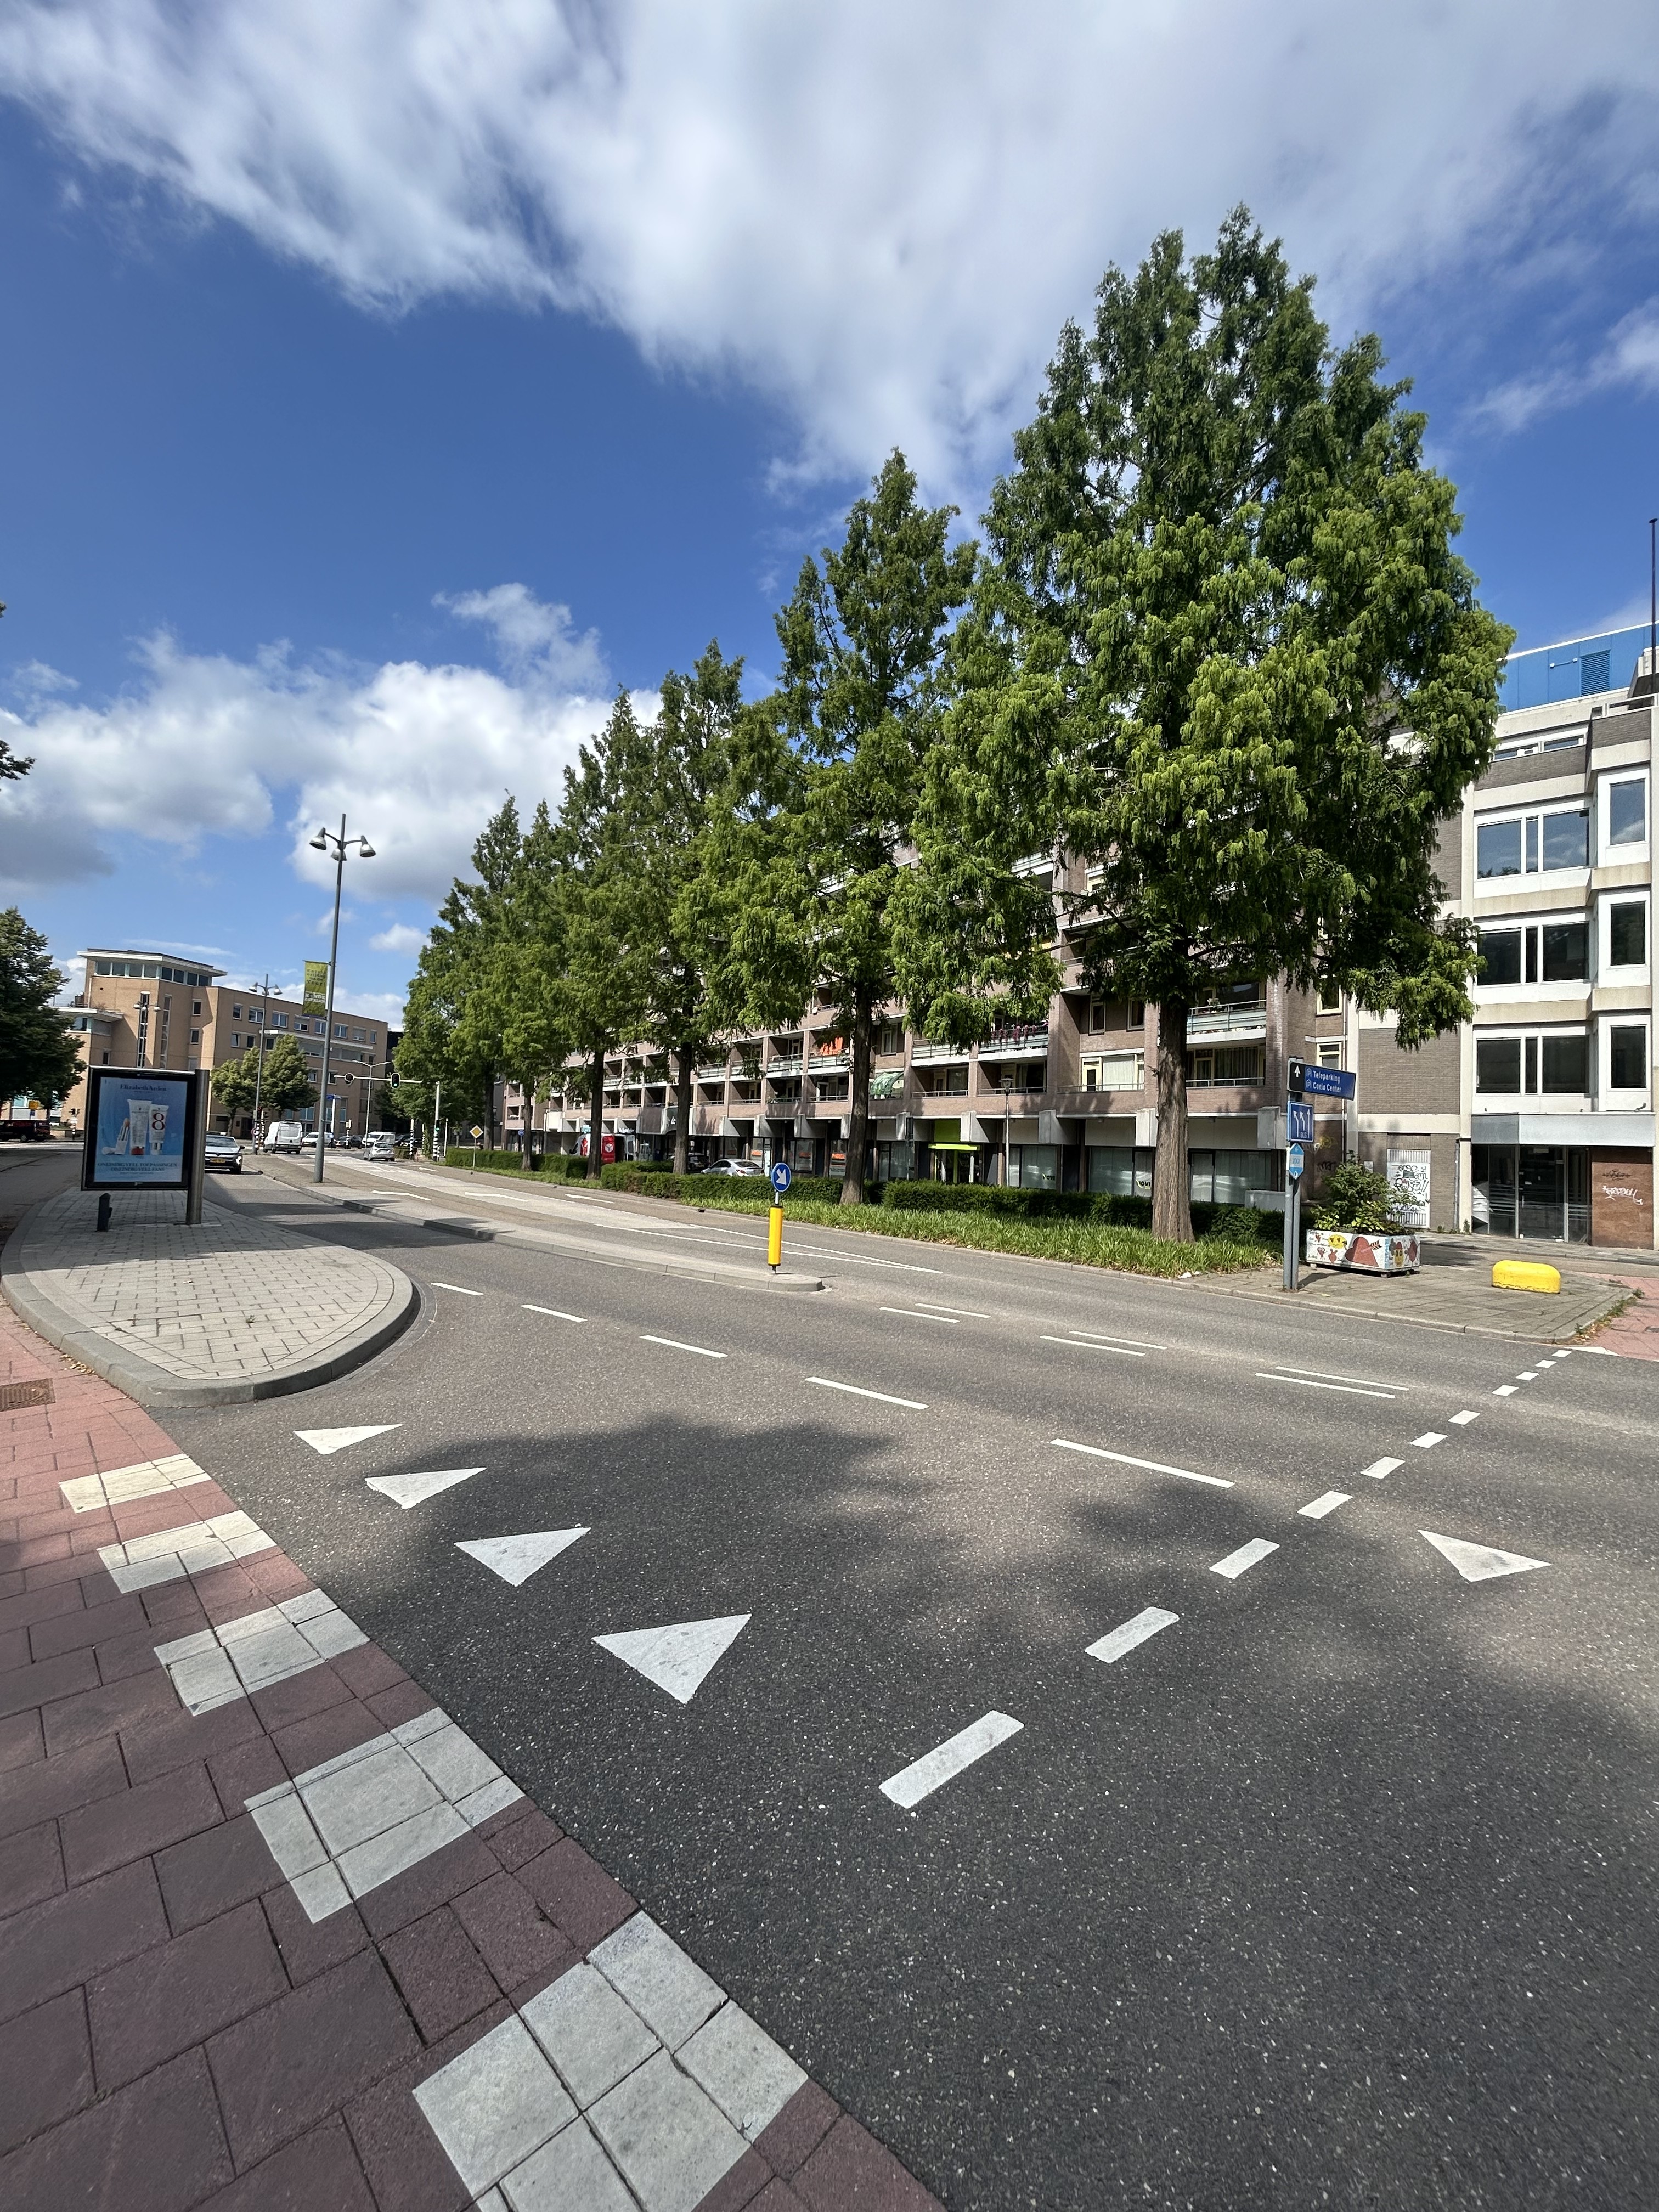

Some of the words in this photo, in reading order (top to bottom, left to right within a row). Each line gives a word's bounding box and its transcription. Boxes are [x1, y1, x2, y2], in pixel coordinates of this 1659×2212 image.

[1313, 1070, 1340, 1084] Teleparking
[1313, 1082, 1325, 1091] Corio
[1327, 1084, 1342, 1093] Center
[151, 1113, 166, 1130] 8
